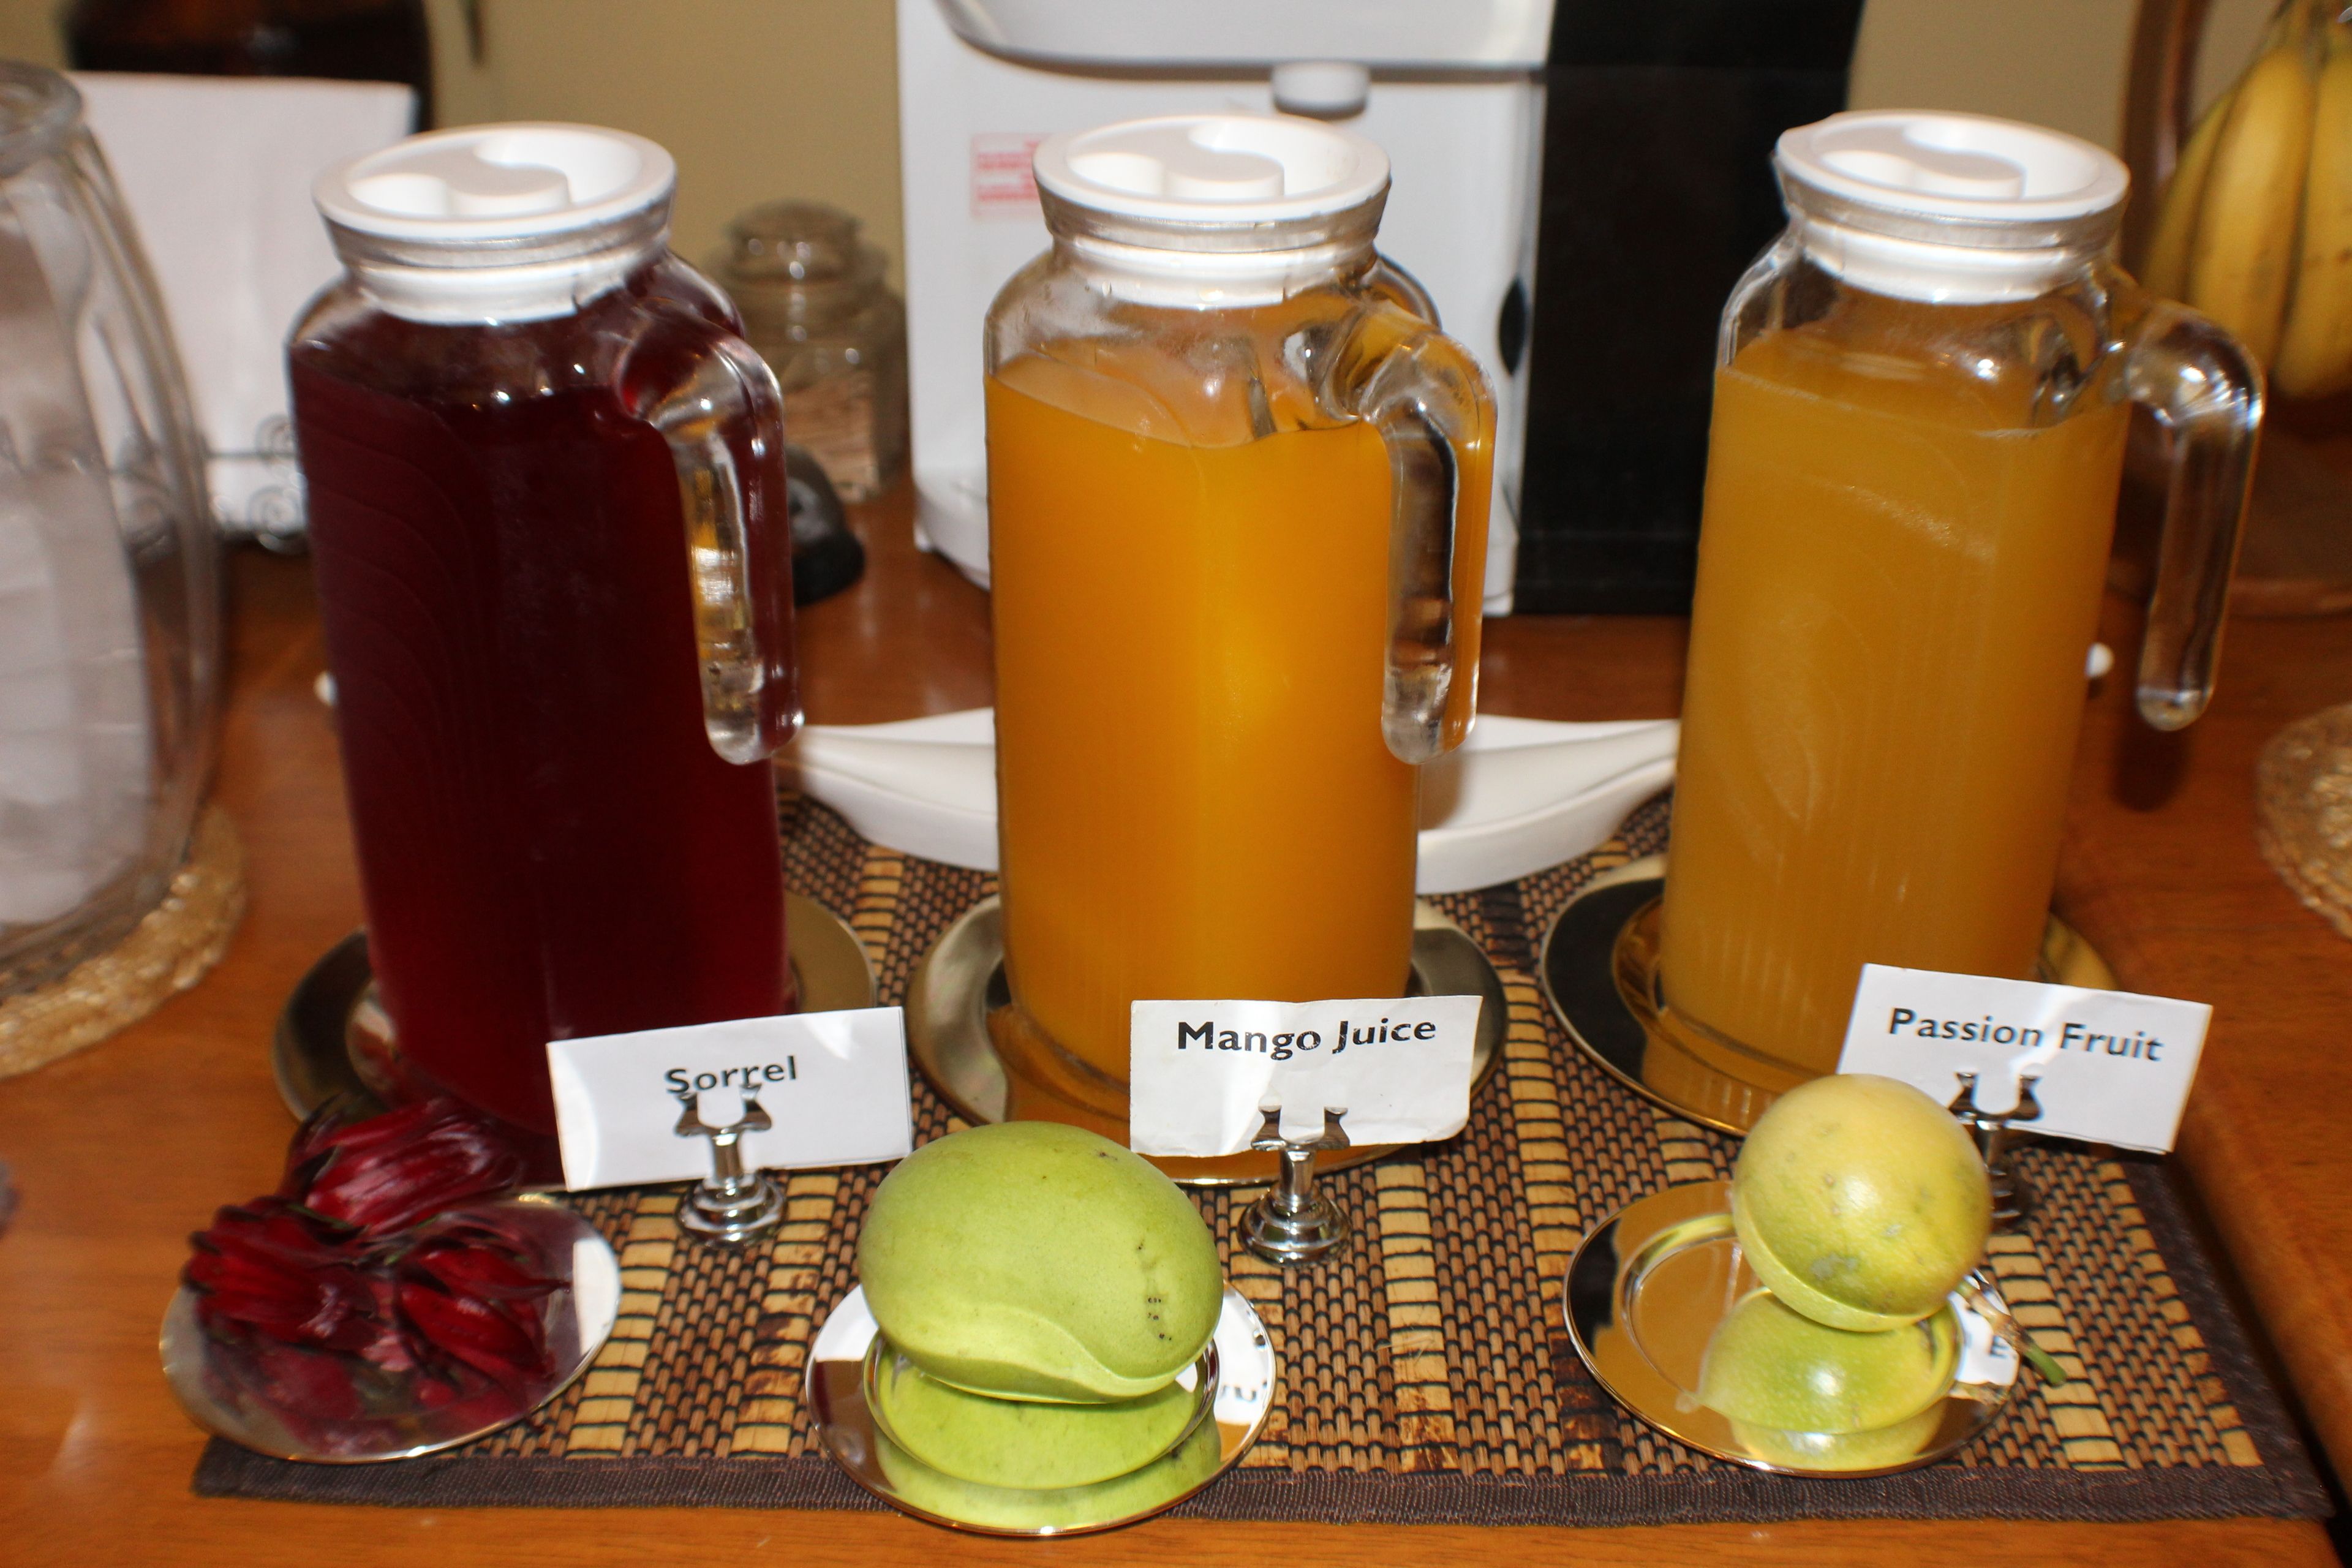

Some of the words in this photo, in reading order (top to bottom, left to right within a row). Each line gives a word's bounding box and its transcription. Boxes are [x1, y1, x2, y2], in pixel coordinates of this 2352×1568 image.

[1178, 1021, 1322, 1060] Mango
[1332, 1017, 1436, 1054] Juice
[1888, 1007, 2044, 1047] Passion
[2059, 1022, 2165, 1061] Fruit
[665, 1055, 796, 1094] Sorrel
